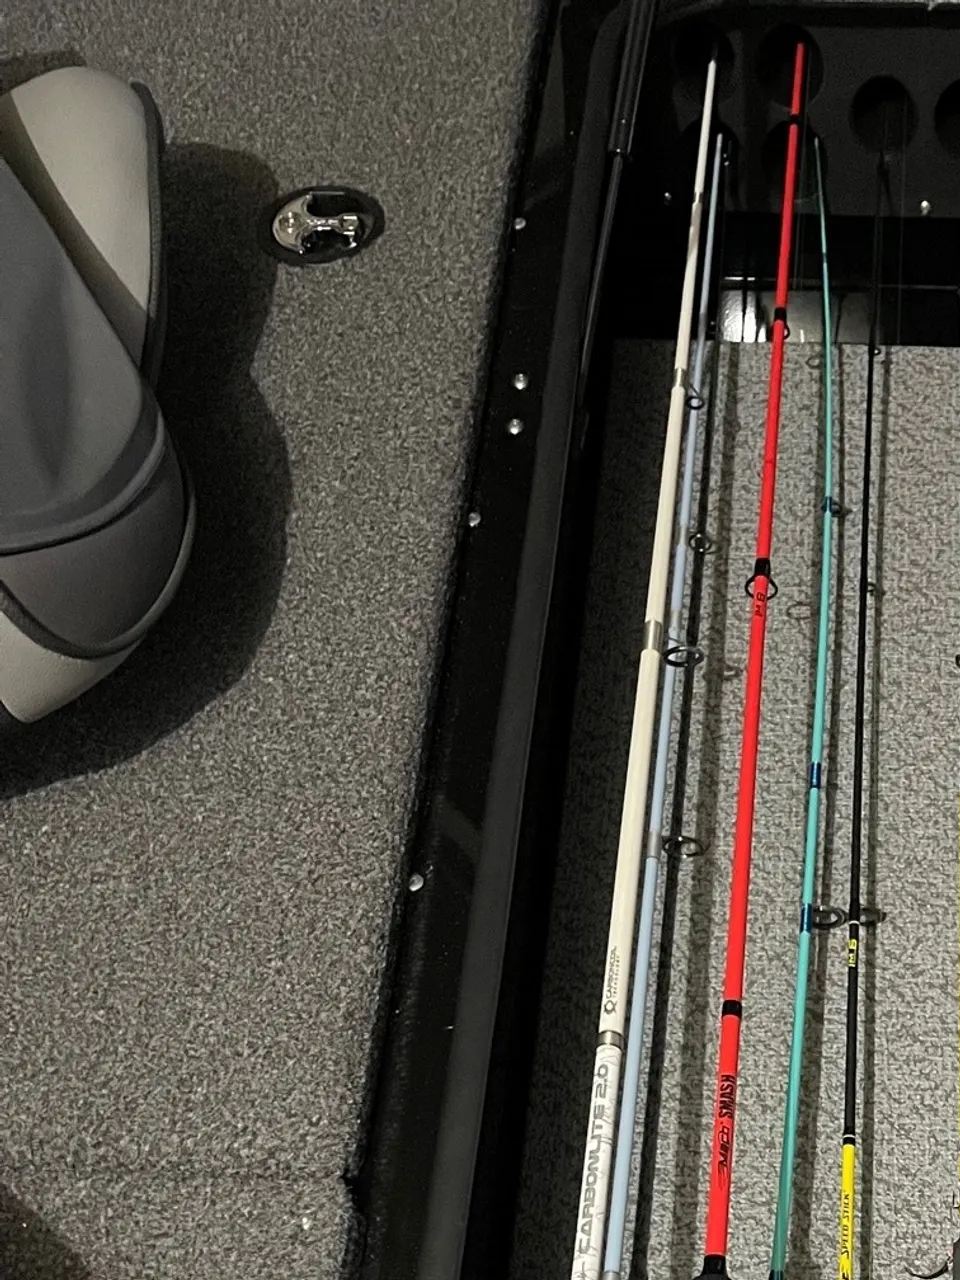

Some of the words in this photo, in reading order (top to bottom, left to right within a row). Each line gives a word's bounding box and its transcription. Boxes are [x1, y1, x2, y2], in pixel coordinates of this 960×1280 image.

[718, 1074, 737, 1119] SMASH
[578, 1104, 606, 1255] CARBONLITE
[594, 1063, 609, 1099] 2.0
